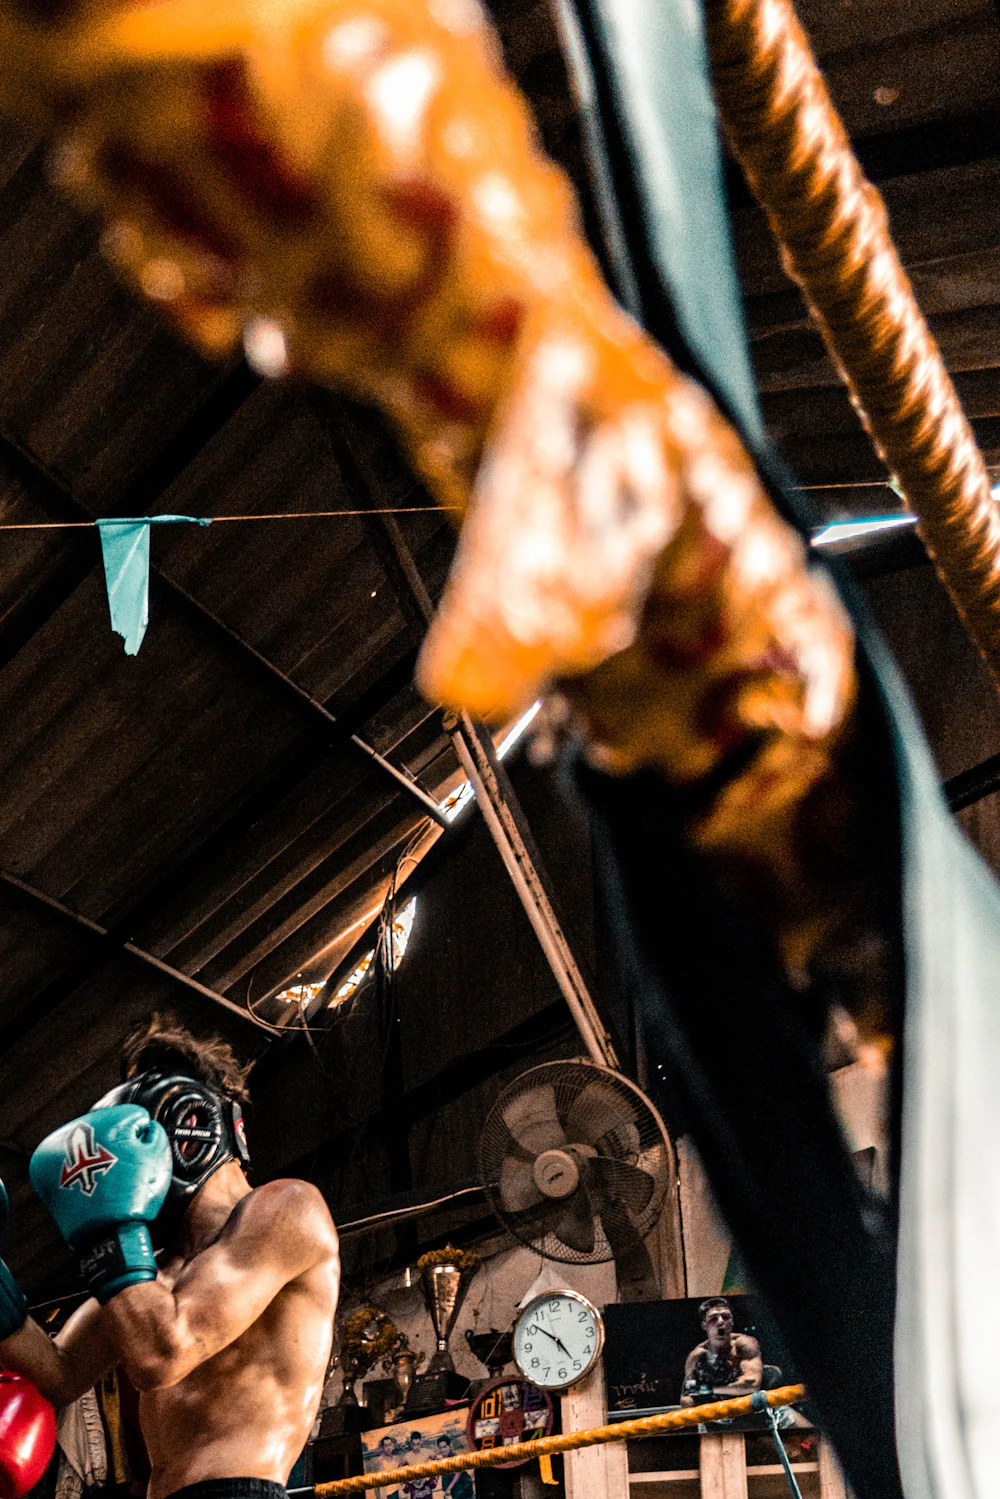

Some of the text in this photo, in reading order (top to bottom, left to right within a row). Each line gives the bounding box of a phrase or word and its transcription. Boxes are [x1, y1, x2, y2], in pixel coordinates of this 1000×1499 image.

[548, 1301, 561, 1313] 12
[568, 1303, 573, 1313] 1
[535, 1311, 545, 1322] 11
[578, 1311, 588, 1323] 2
[526, 1325, 538, 1336] 10
[585, 1326, 595, 1338] 3
[524, 1343, 533, 1353] 9
[583, 1345, 592, 1355] 4
[531, 1357, 540, 1368] 8
[572, 1360, 582, 1371] 5
[542, 1367, 551, 1378] 7
[558, 1368, 568, 1379] 6
